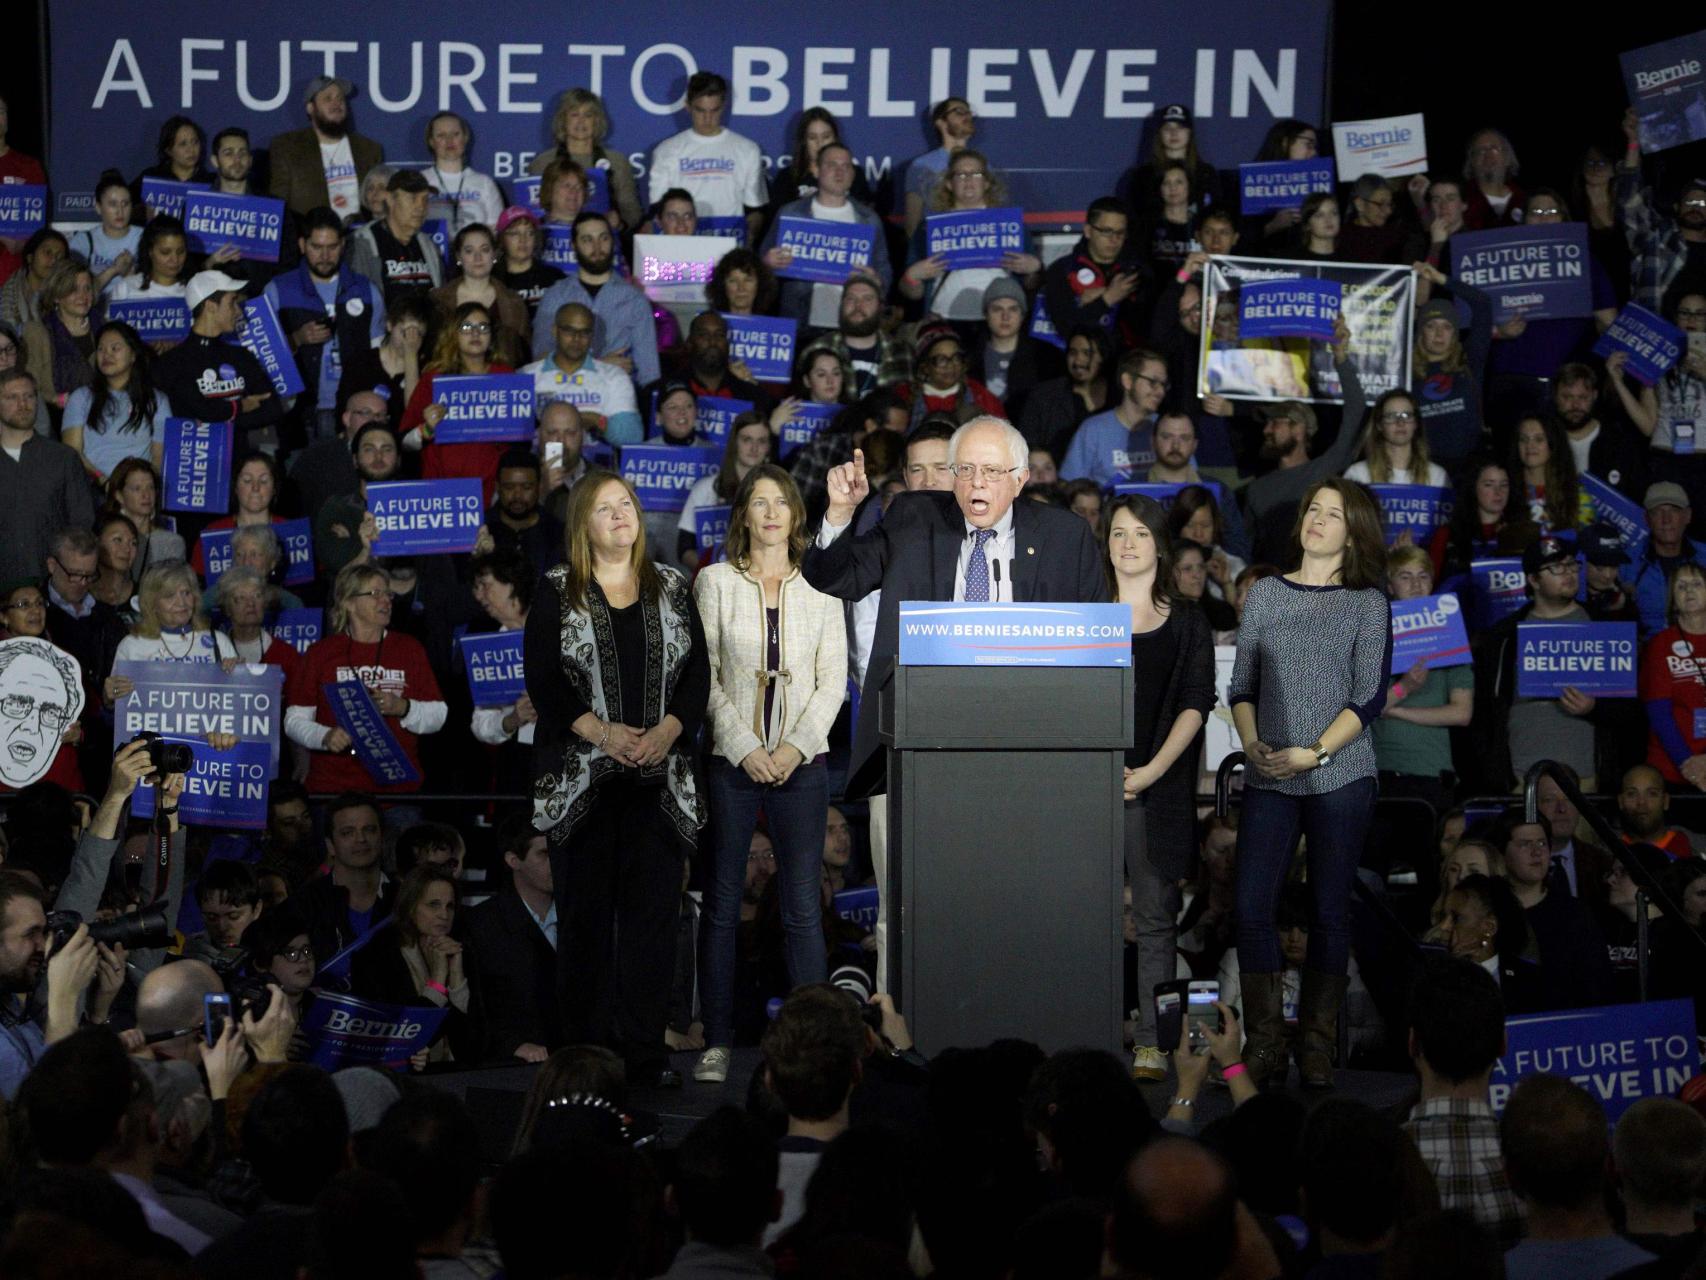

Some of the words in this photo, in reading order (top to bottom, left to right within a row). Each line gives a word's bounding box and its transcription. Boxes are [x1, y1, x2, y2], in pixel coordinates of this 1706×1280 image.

[92, 38, 153, 110] A
[180, 39, 543, 114] FUTURE
[568, 43, 699, 116] TO
[731, 45, 1158, 119] BELIEVE
[1193, 48, 1297, 118] IN
[1634, 58, 1702, 90] Bernie
[1345, 126, 1412, 149] Bernie
[680, 157, 734, 173] Bernie
[1245, 174, 1255, 184] A
[1256, 173, 1308, 184] FUTURE
[1312, 170, 1330, 181] TO
[1244, 183, 1308, 198] BELIEVE
[1313, 182, 1331, 193] IN
[24, 197, 43, 207] TO
[65, 198, 91, 209] PAID
[158, 193, 186, 206] FUT
[25, 209, 42, 222] IN
[191, 204, 201, 216] A
[204, 206, 256, 222] FUTURE
[262, 211, 280, 226] TO
[189, 218, 256, 238] BELIEVE
[260, 226, 278, 241] IN
[931, 227, 942, 239] A
[943, 223, 998, 237] FUTURE
[1001, 222, 1020, 234] TO
[783, 229, 793, 241] A
[795, 231, 848, 246] FUTURE
[851, 238, 870, 252] TO
[931, 236, 998, 253] BELIEVE
[1001, 235, 1020, 248] IN
[849, 252, 868, 266] IN
[1460, 255, 1473, 269] A
[1476, 246, 1550, 266] FUTURE
[1553, 244, 1581, 259] TO
[644, 256, 714, 281] Berni
[1460, 262, 1553, 285] BELIEVE
[1557, 260, 1582, 278] IN
[1245, 294, 1256, 305] A
[1258, 292, 1315, 305] FUTURE
[1319, 293, 1338, 306] TO
[115, 310, 125, 320] A
[128, 308, 184, 321] FUTURE
[245, 305, 257, 317] A
[1244, 304, 1316, 321] BELIEVE
[1320, 308, 1338, 322] IN
[130, 318, 186, 331] ELIEVE
[247, 316, 280, 373] FUTURE
[728, 329, 768, 345] TURE
[771, 332, 792, 347] TO
[1626, 316, 1663, 346] FUTURE
[1662, 339, 1680, 358] TO
[729, 344, 768, 360] IEVE
[770, 346, 790, 362] IN
[1607, 324, 1653, 358] BELIEVE
[1651, 353, 1671, 370] IN
[196, 374, 246, 396] Bernie
[271, 374, 289, 396] TO
[438, 392, 448, 404] A
[451, 390, 508, 405] FUTURE
[510, 389, 532, 402] TO
[512, 404, 532, 419] IN
[182, 420, 195, 438] TO
[196, 421, 211, 439] IN
[177, 440, 193, 493] FUTURE
[191, 441, 209, 507] BELIEVE
[625, 459, 636, 472] A
[638, 459, 696, 476] FUTURE
[698, 464, 720, 477] TO
[177, 495, 190, 506] A
[374, 500, 386, 514] A
[389, 497, 453, 514] FUTURE
[456, 495, 479, 510] TO
[1380, 498, 1429, 511] UTURE
[1433, 500, 1453, 512] TO
[375, 513, 454, 532] BELIEVE
[459, 511, 481, 527] IN
[286, 534, 308, 548] TO
[209, 545, 220, 558] A
[289, 548, 309, 565] IN
[295, 623, 318, 638] TO
[905, 623, 1125, 640] WWW.BERNIESANDERS.COM
[1523, 640, 1536, 654] A
[1539, 640, 1605, 655] FUTURE
[1609, 640, 1632, 655] TO
[471, 652, 481, 665] A
[484, 649, 524, 664] FUTU
[1523, 656, 1606, 672] BELIEVE
[1610, 656, 1632, 672] IN
[472, 663, 525, 683] BELIE
[127, 691, 143, 709] A
[148, 690, 234, 711] FUTURE
[240, 692, 271, 712] TO
[126, 711, 235, 736] BELIEVE
[242, 714, 270, 736] IN
[338, 687, 383, 760] BELIEVE
[380, 761, 398, 781] IN
[354, 699, 394, 758] FUTURE
[390, 758, 406, 779] TO
[195, 759, 232, 778] URE
[237, 763, 264, 780] TO
[238, 782, 264, 802] IN
[159, 836, 169, 867] Canon
[323, 1008, 422, 1041] Bernie
[1515, 1040, 1637, 1074] FUTURE
[1644, 1034, 1689, 1062] TO
[1652, 1064, 1693, 1096] IN
